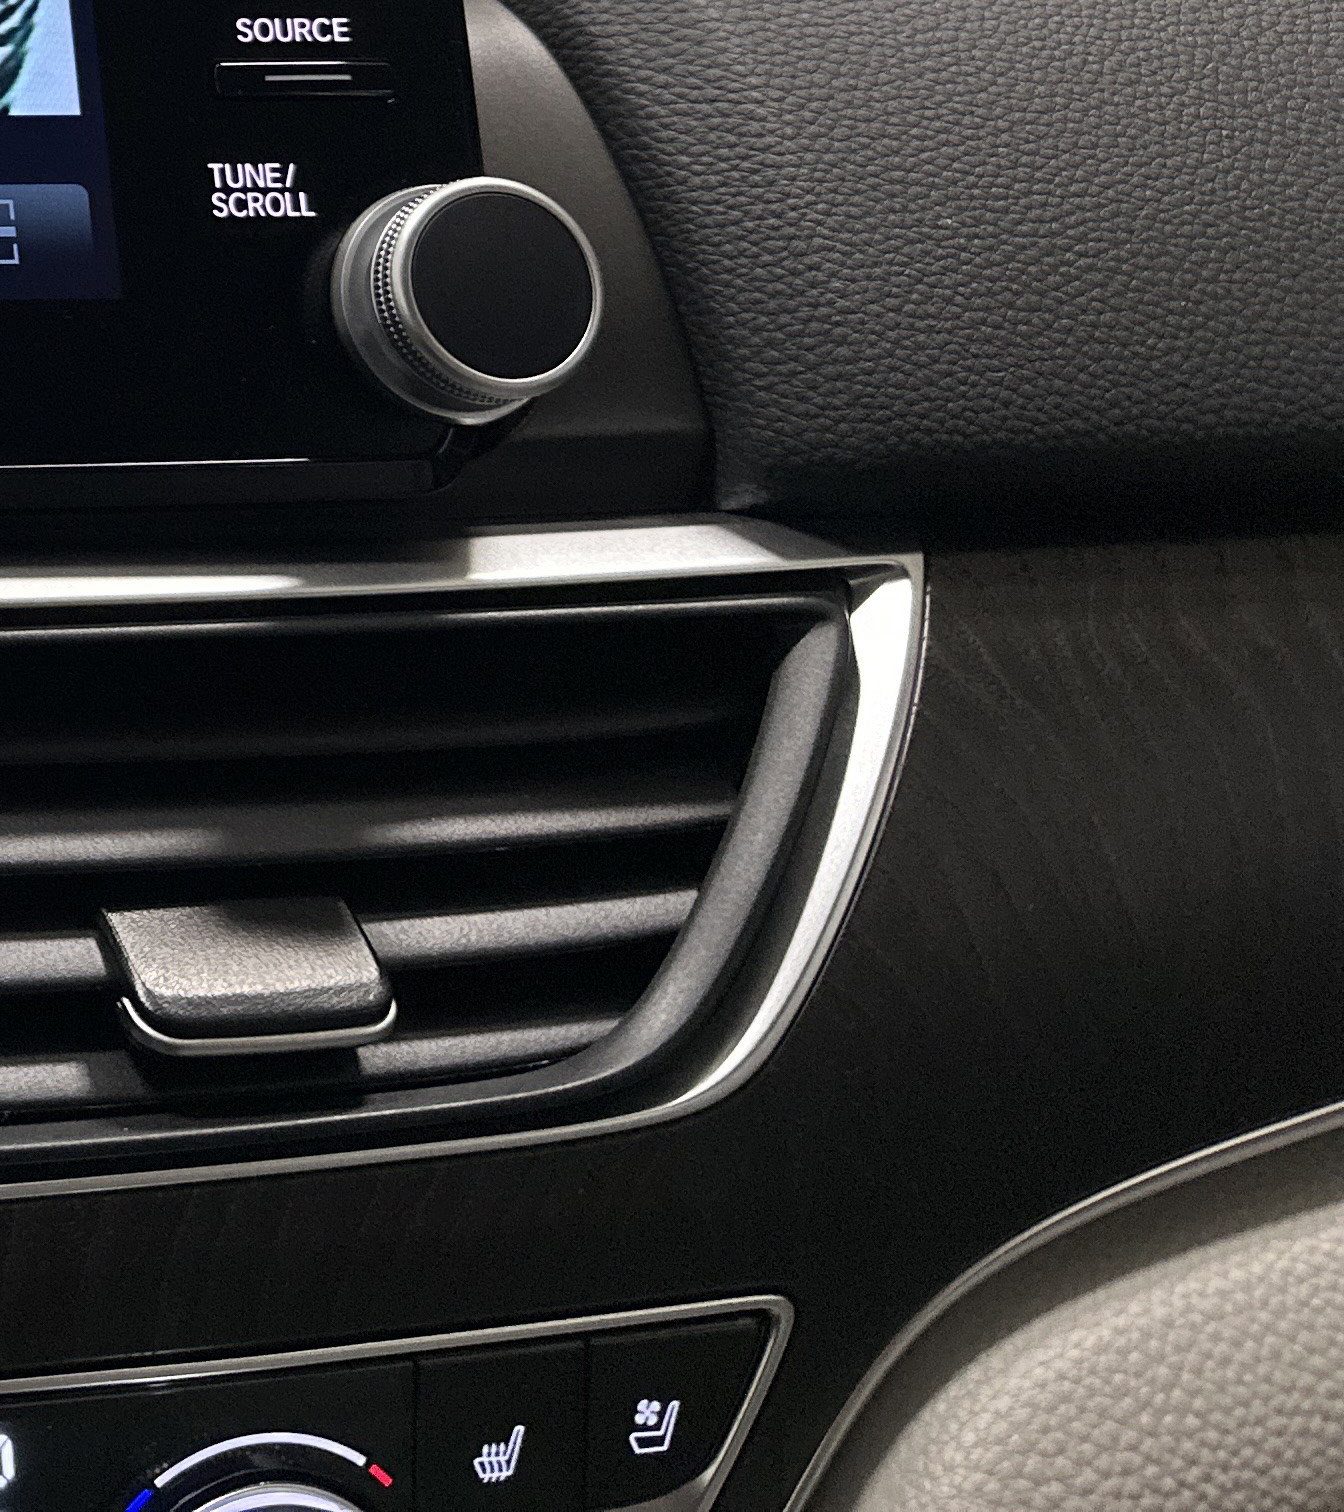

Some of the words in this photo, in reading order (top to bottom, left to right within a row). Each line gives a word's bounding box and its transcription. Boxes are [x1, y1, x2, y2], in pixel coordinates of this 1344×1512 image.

[235, 17, 352, 43] SOURCE
[206, 162, 296, 189] TUNE/
[211, 191, 317, 218] SCROLL
